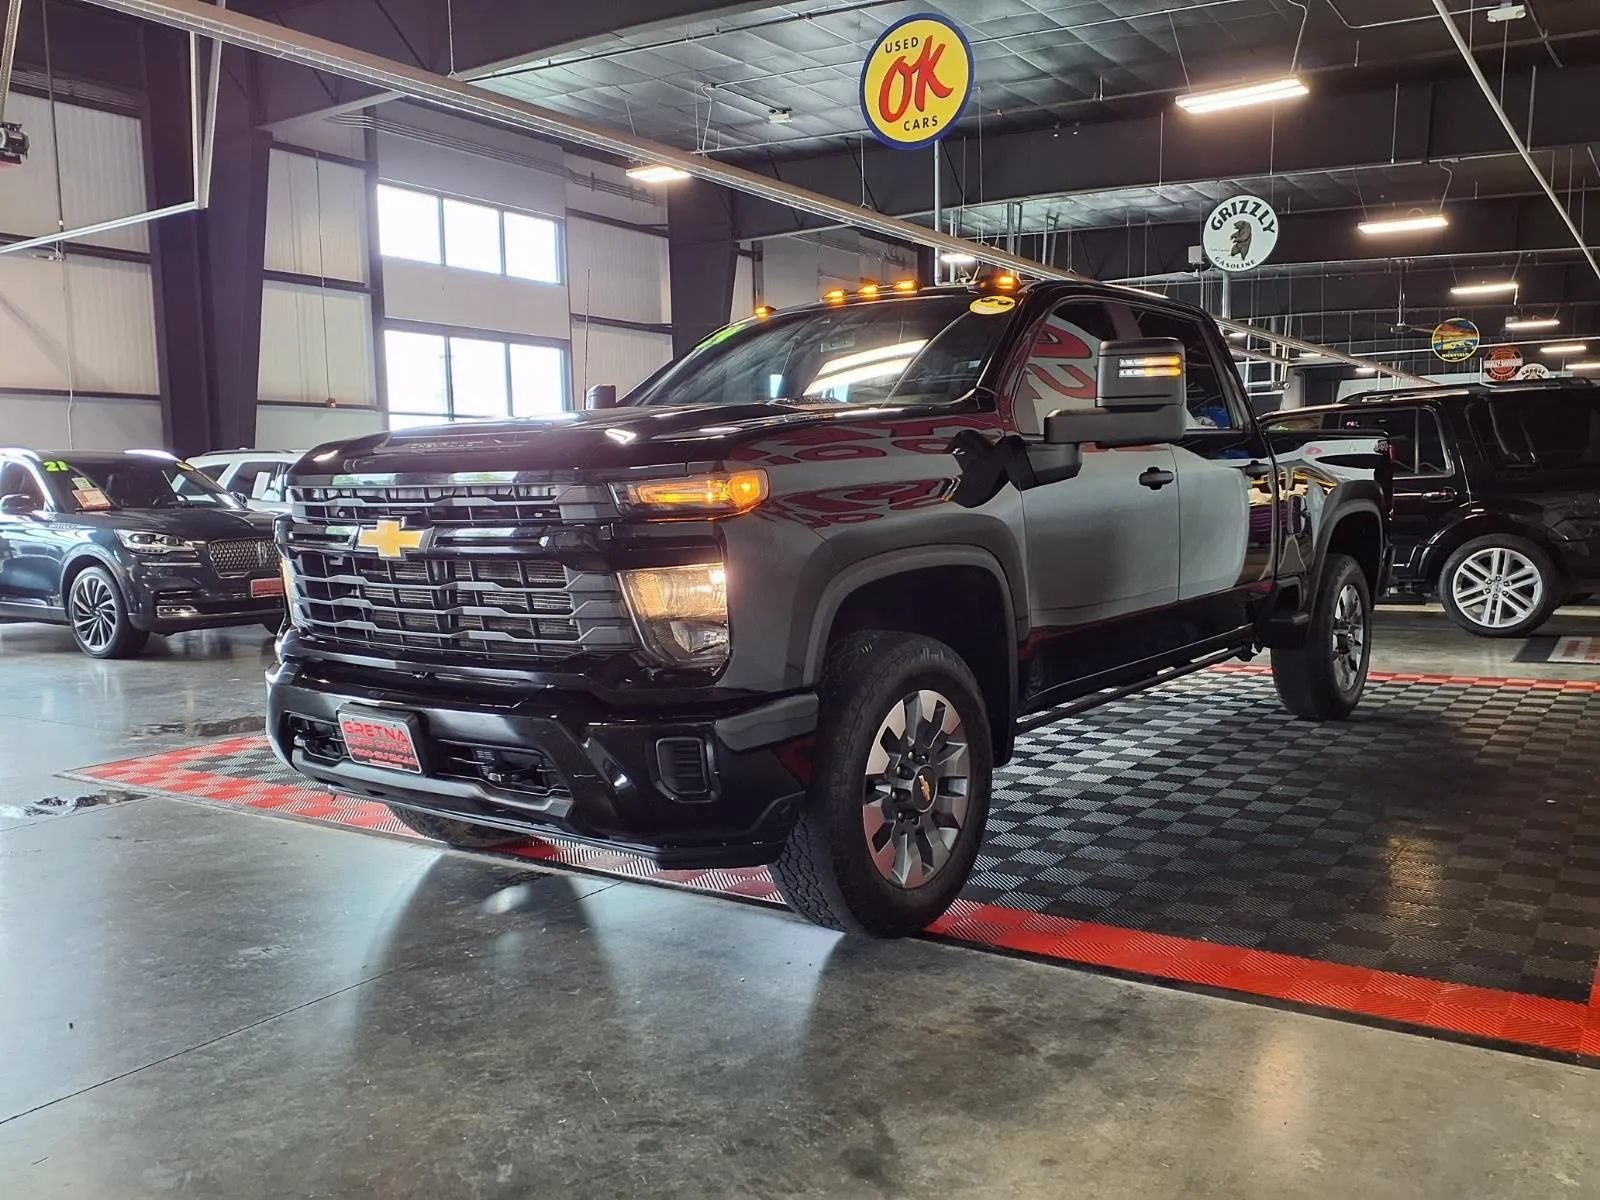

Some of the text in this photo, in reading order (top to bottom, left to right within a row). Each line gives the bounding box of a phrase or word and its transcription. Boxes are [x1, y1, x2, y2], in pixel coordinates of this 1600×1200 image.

[885, 36, 919, 53] USED
[878, 34, 955, 124] OK
[903, 115, 939, 132] CARS
[1210, 199, 1276, 235] GRIZZLY
[1215, 256, 1255, 269] GASOLINE
[43, 460, 69, 472] 21
[343, 721, 408, 743] GRETNA
